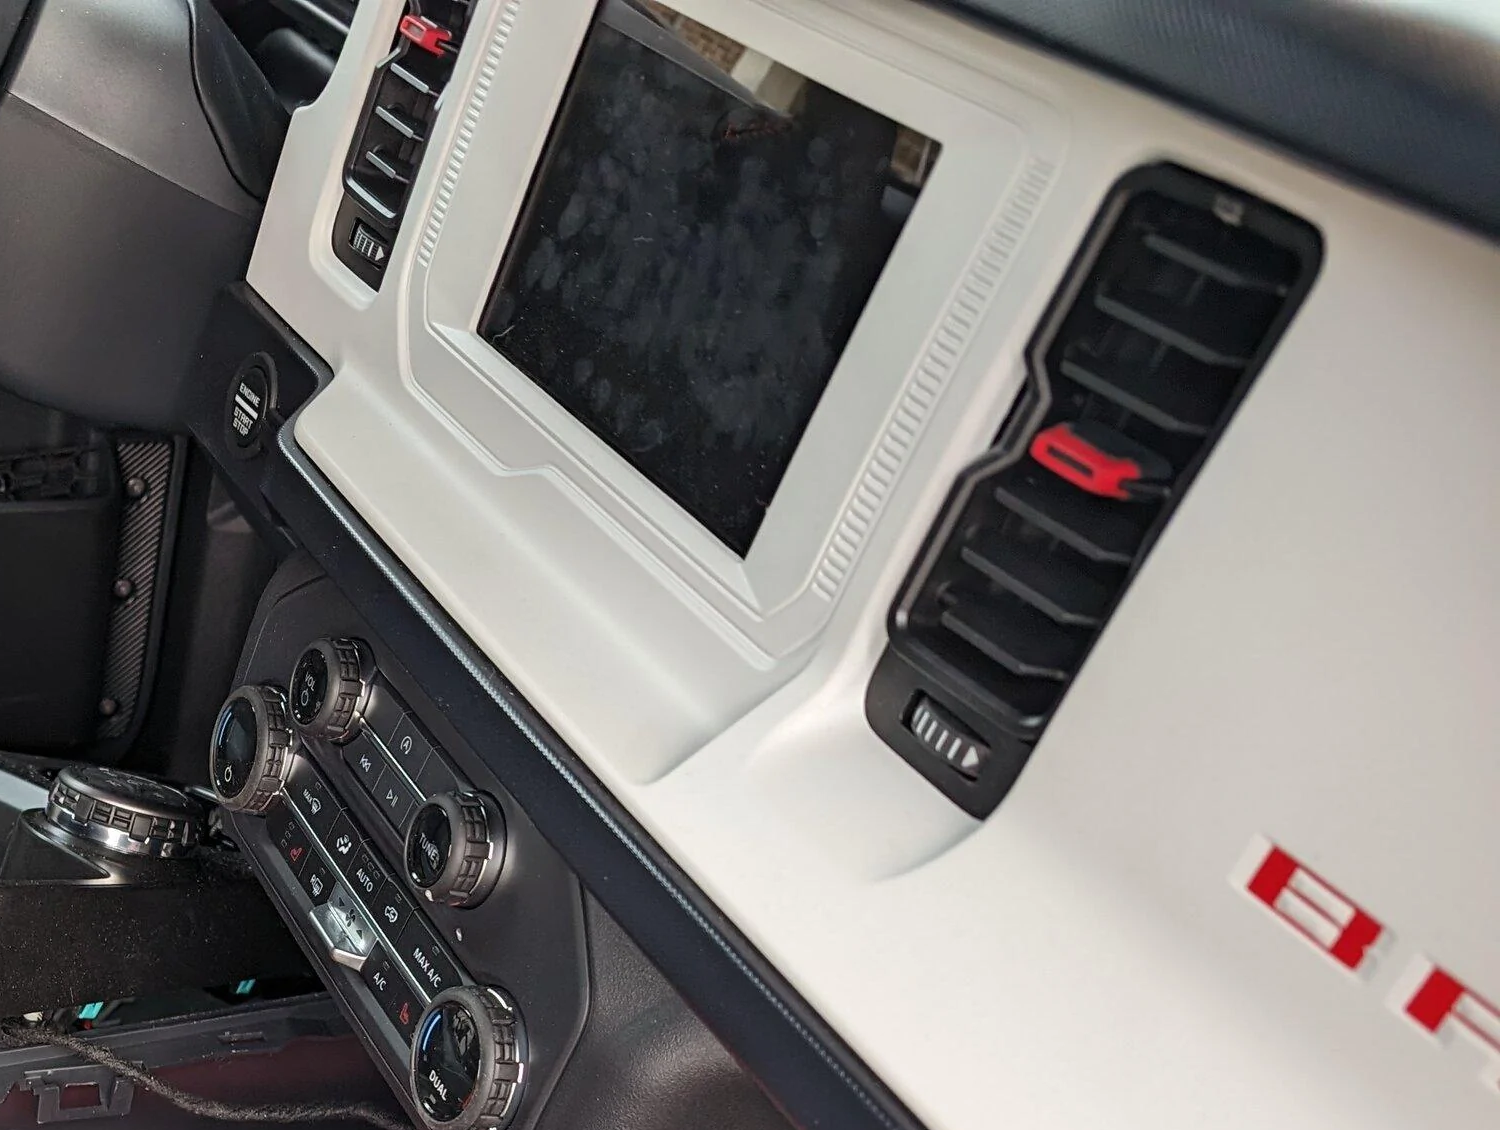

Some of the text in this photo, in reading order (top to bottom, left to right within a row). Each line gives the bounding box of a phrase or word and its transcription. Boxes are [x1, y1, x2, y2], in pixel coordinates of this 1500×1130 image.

[239, 381, 260, 408] ENGINE
[232, 417, 249, 436] STOP
[233, 405, 254, 430] START
[305, 672, 316, 692] VOL
[356, 867, 374, 893] AUTO
[413, 947, 442, 988] MAX A/C
[373, 972, 387, 991] A/C
[428, 1069, 449, 1101] DUAL
